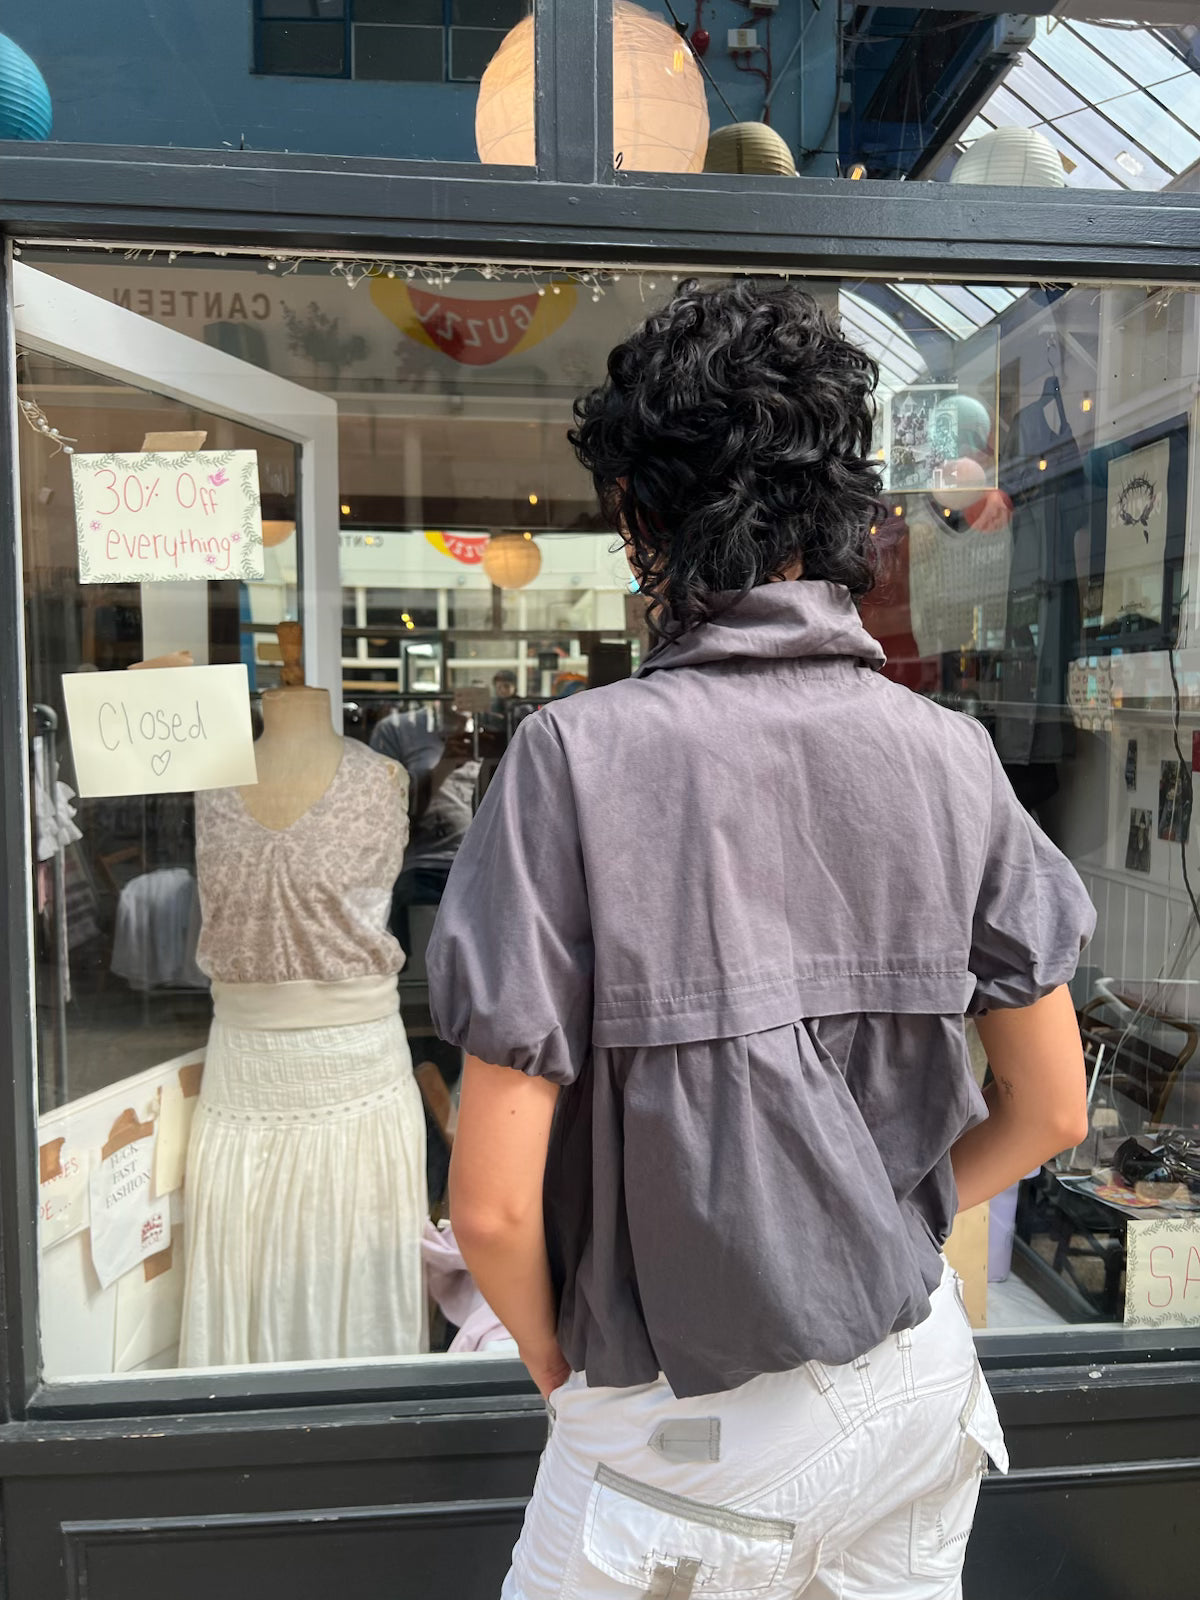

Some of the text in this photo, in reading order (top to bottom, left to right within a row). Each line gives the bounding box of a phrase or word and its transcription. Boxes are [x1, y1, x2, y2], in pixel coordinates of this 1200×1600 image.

[94, 469, 218, 516] 30% Off
[106, 529, 231, 571] everything
[99, 700, 208, 751] Closed
[105, 1169, 152, 1209] FASHION
[112, 1159, 138, 1185] FAST
[1147, 1245, 1200, 1308] SA
